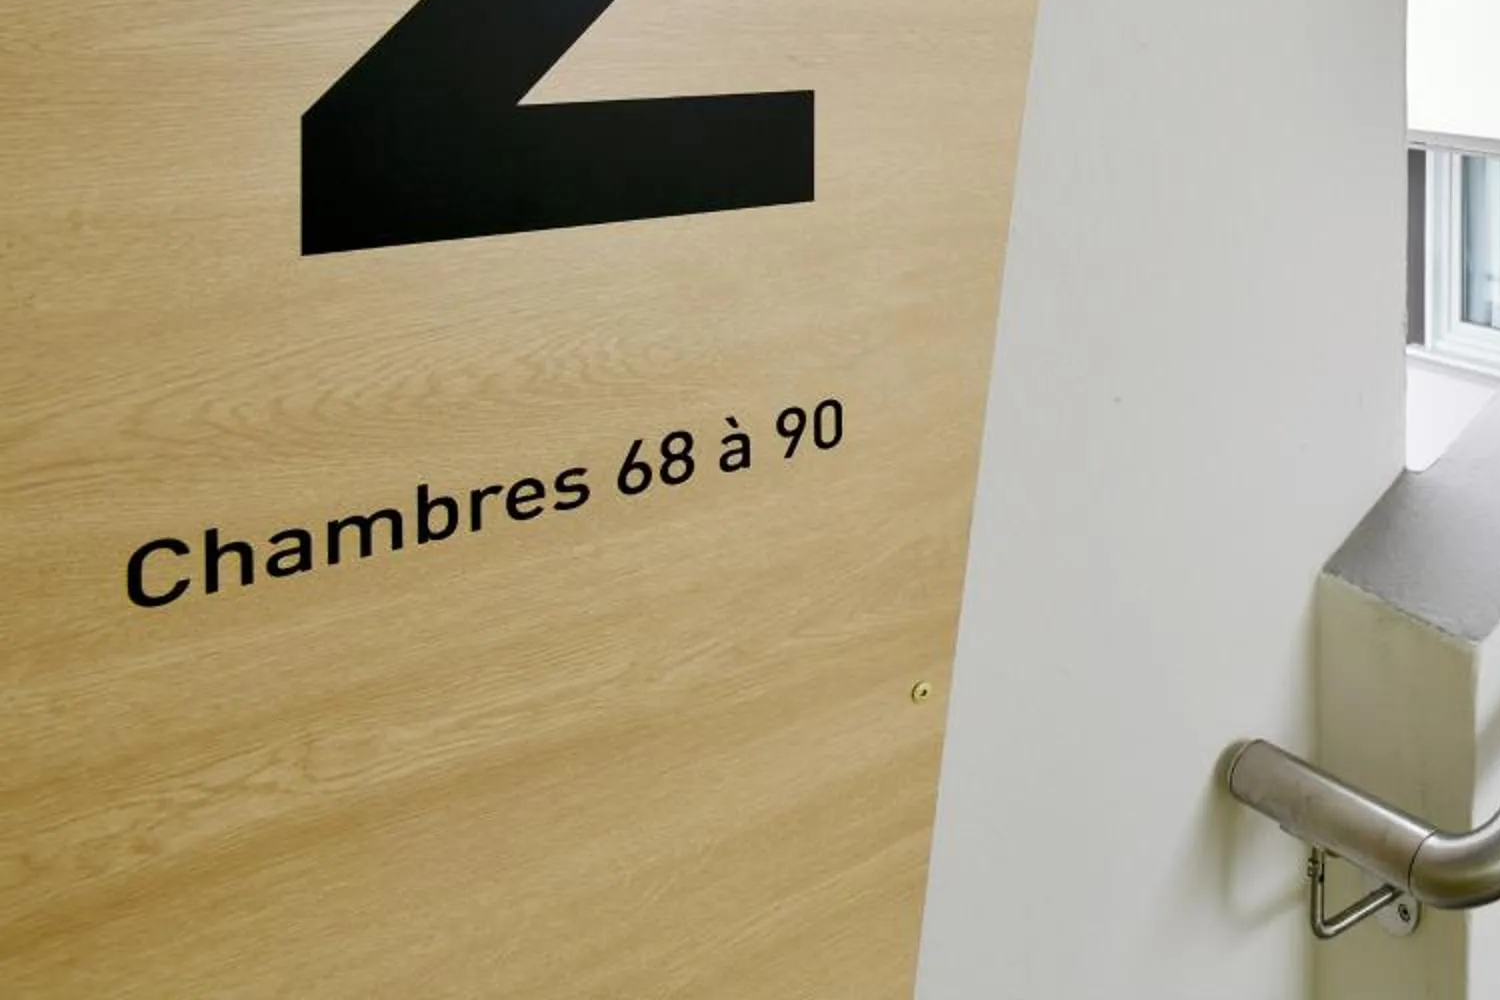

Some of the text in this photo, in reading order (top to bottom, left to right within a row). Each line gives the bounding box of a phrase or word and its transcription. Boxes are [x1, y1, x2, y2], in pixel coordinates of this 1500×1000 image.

[125, 398, 843, 609] Chambres 68 à 90
